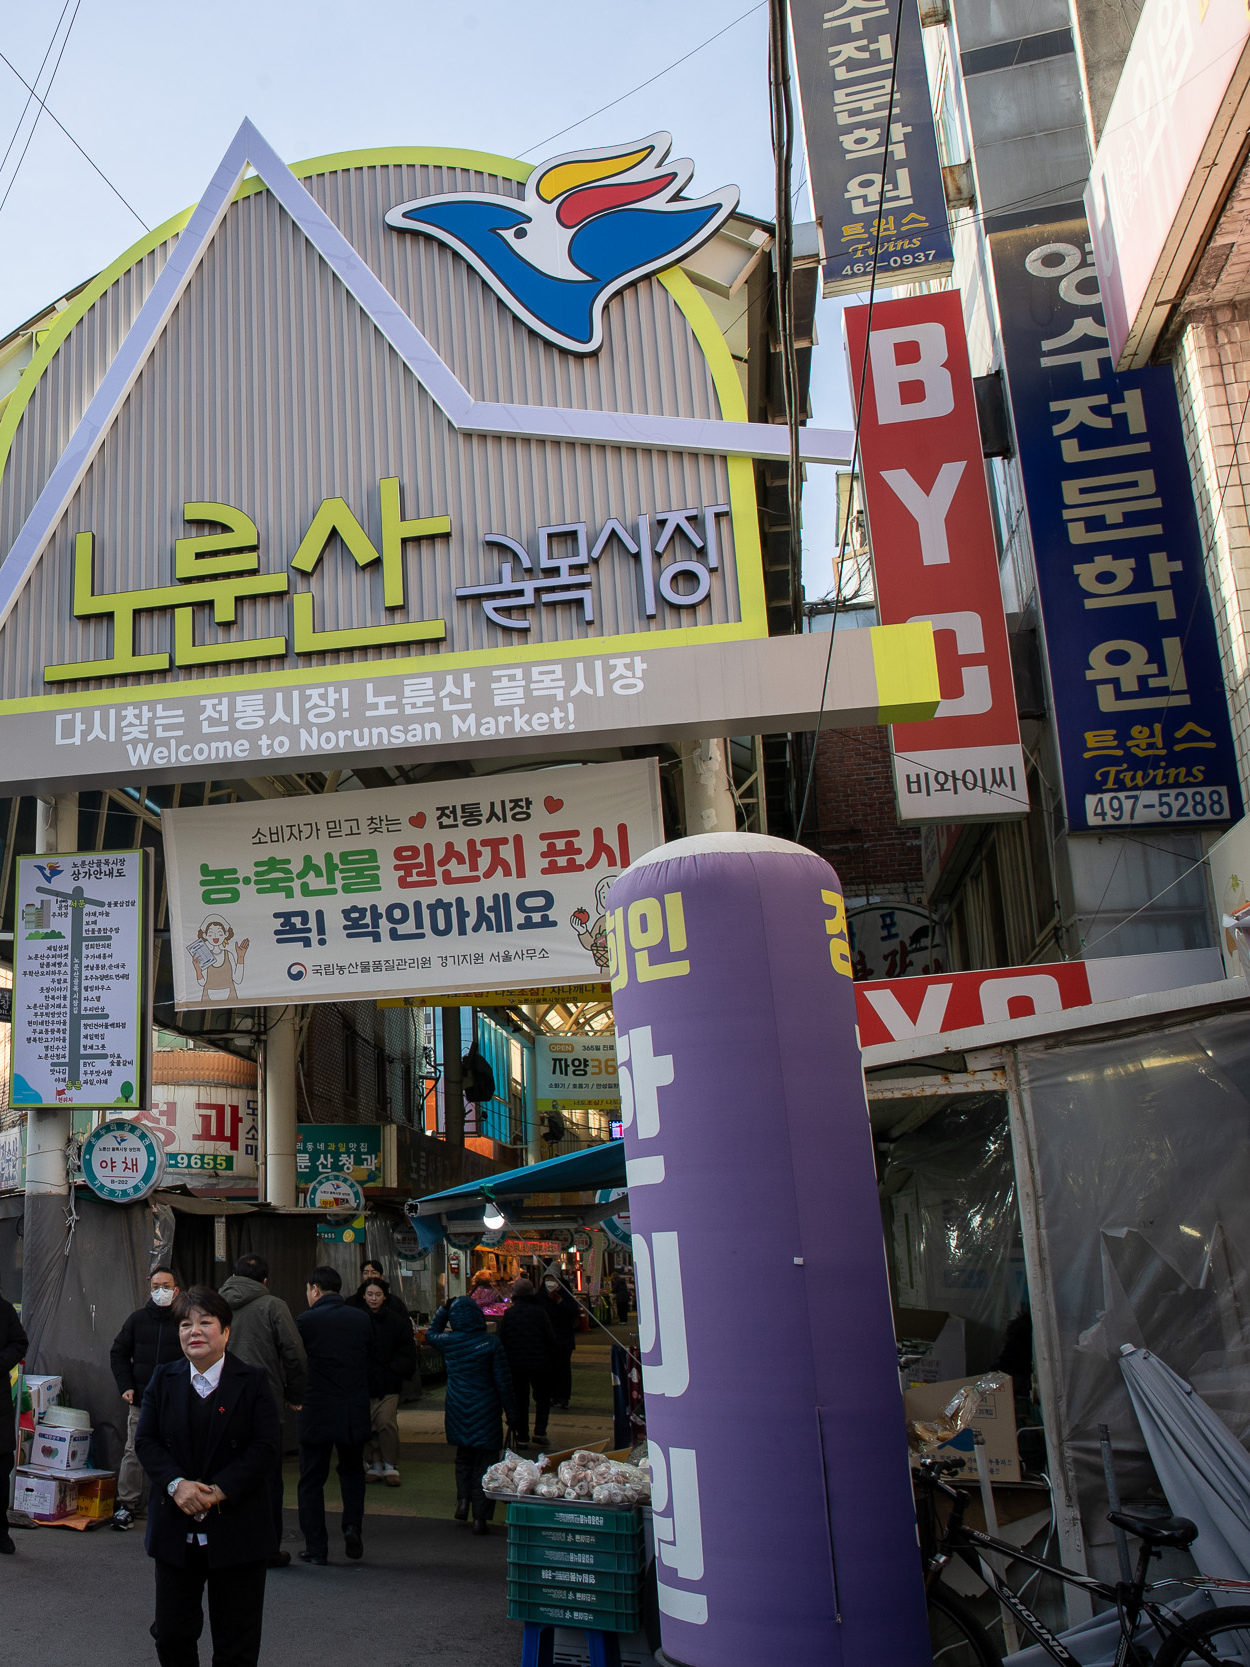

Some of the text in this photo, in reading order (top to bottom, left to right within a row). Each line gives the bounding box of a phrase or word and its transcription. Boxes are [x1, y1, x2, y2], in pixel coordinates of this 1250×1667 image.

[840, 212, 929, 241] 트윈스
[848, 233, 922, 260] Twins
[841, 250, 936, 277] 462-0937
[1025, 242, 1191, 713] 영수전문학원
[869, 322, 993, 718] BYC
[44, 475, 451, 684] 노룬산
[455, 503, 730, 631] 골목시장
[55, 656, 648, 746] 다시찾는 전통시장! 노룬산 골목시장
[126, 702, 575, 766] Welcome to Norunsan Market!
[1083, 721, 1216, 759] 트윈스
[905, 766, 1016, 797] 비와이씨
[1095, 761, 1205, 790] Twins
[251, 796, 533, 846] 소비자가 믿고 찾는 전통시장
[1092, 790, 1225, 823] 497-5288
[71, 858, 126, 868] 노룬산골목시장
[71, 868, 126, 881] 상가안내도
[198, 823, 630, 905] 농·축산물 원산지 표시
[272, 890, 557, 948] 꼭! 확인하세요
[311, 947, 550, 978] 국립농산물품질관리원 경기지원 서울사무소
[550, 984, 595, 995] 자나깨나
[551, 1057, 617, 1077] 자양36
[90, 1123, 151, 1146] 온누리상품권
[296, 1142, 368, 1153] 리동네 과일 맛집
[99, 1156, 138, 1173] 야채
[296, 1153, 378, 1173] 룬산청과
[94, 1180, 146, 1198] 카드가맹점
[1010, 1597, 1070, 1660] HOUND
